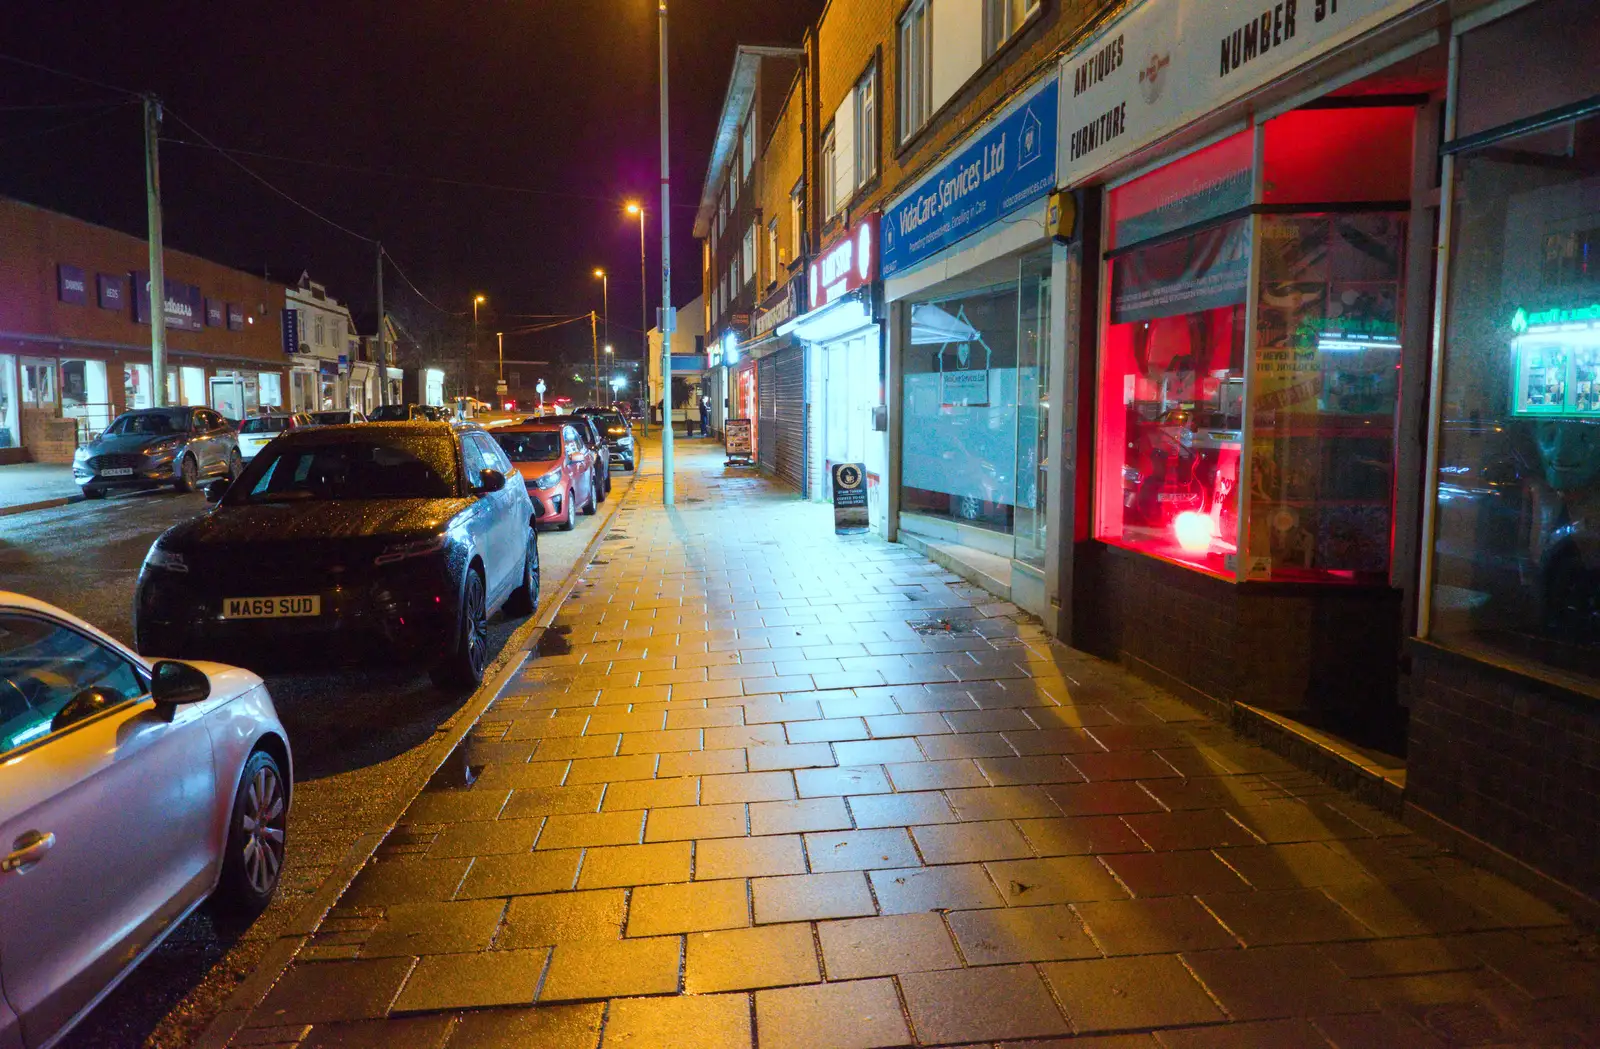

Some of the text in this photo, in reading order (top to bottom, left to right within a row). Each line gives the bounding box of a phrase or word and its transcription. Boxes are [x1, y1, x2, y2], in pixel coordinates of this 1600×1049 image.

[1073, 33, 1125, 98] ANTIQUES
[1220, 0, 1297, 78] NUMBER
[1070, 100, 1126, 162] FURNITURE
[900, 132, 1006, 236] VidaCare Services Ltd
[1192, 166, 1248, 202] Emporium
[230, 598, 313, 616] MA69 SUD
